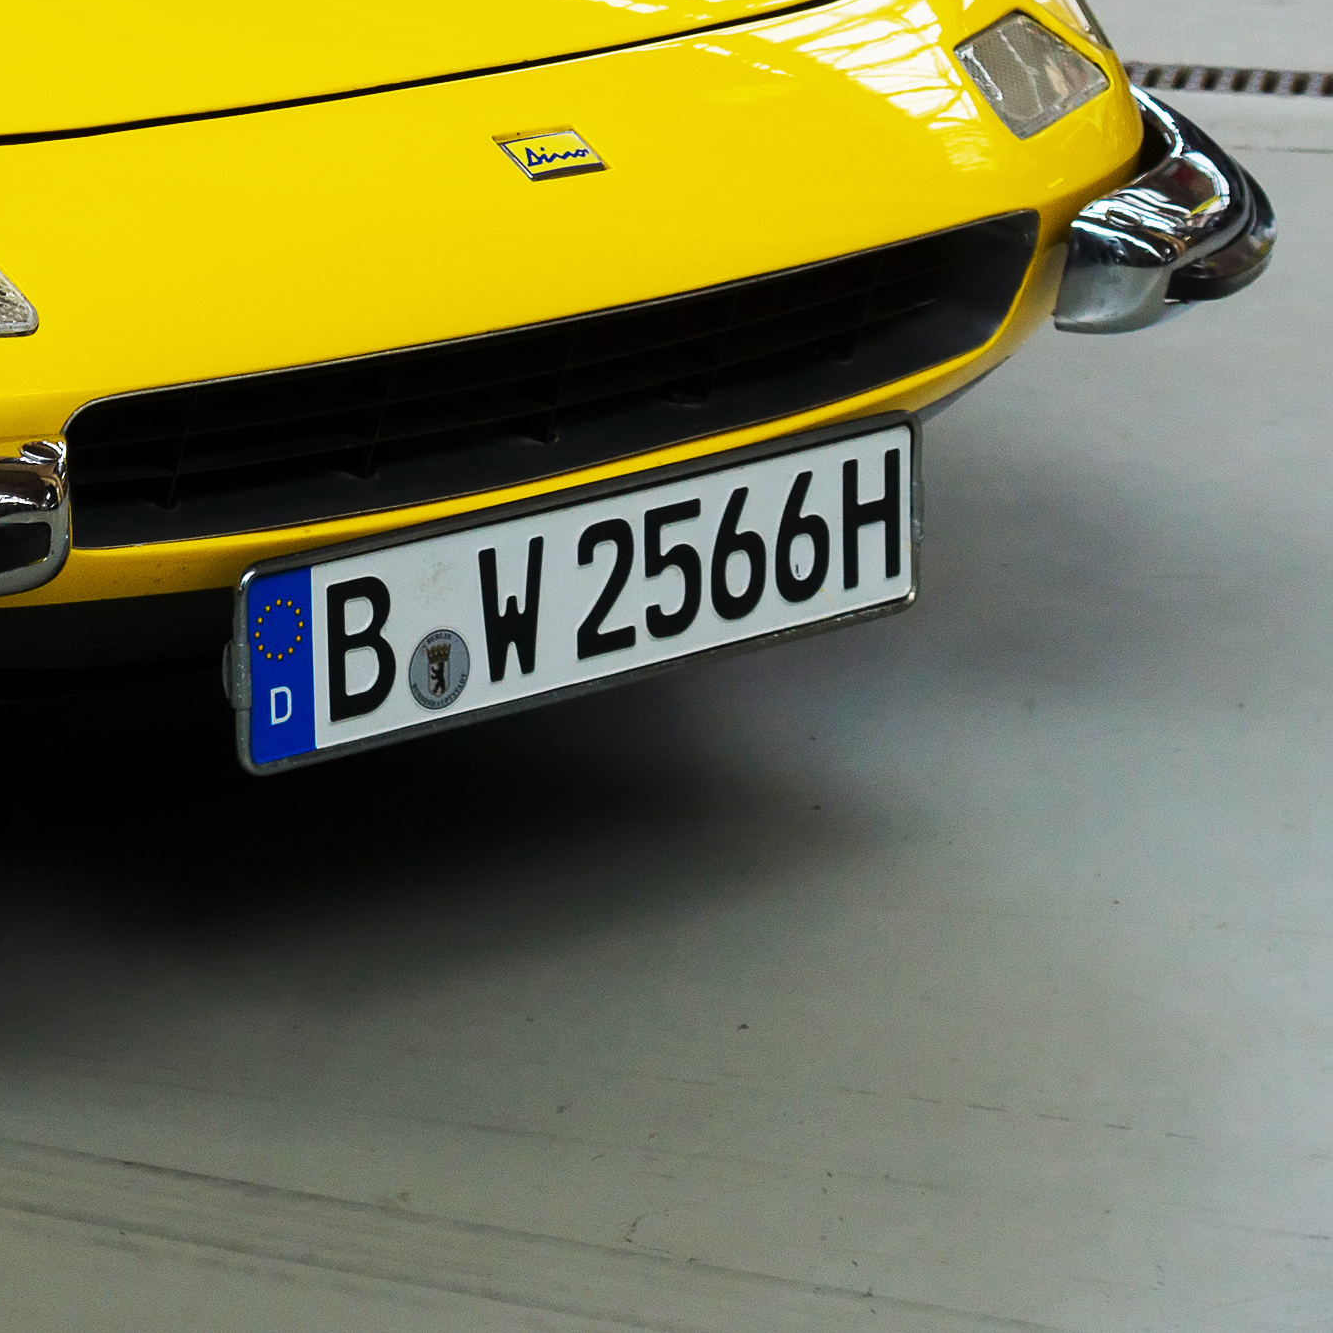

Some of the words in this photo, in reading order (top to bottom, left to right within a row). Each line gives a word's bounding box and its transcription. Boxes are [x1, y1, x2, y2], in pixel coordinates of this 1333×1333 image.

[525, 147, 589, 167] Dino
[326, 576, 396, 722] B
[478, 536, 544, 683] W
[577, 448, 901, 660] 2566H
[270, 687, 292, 725] D
